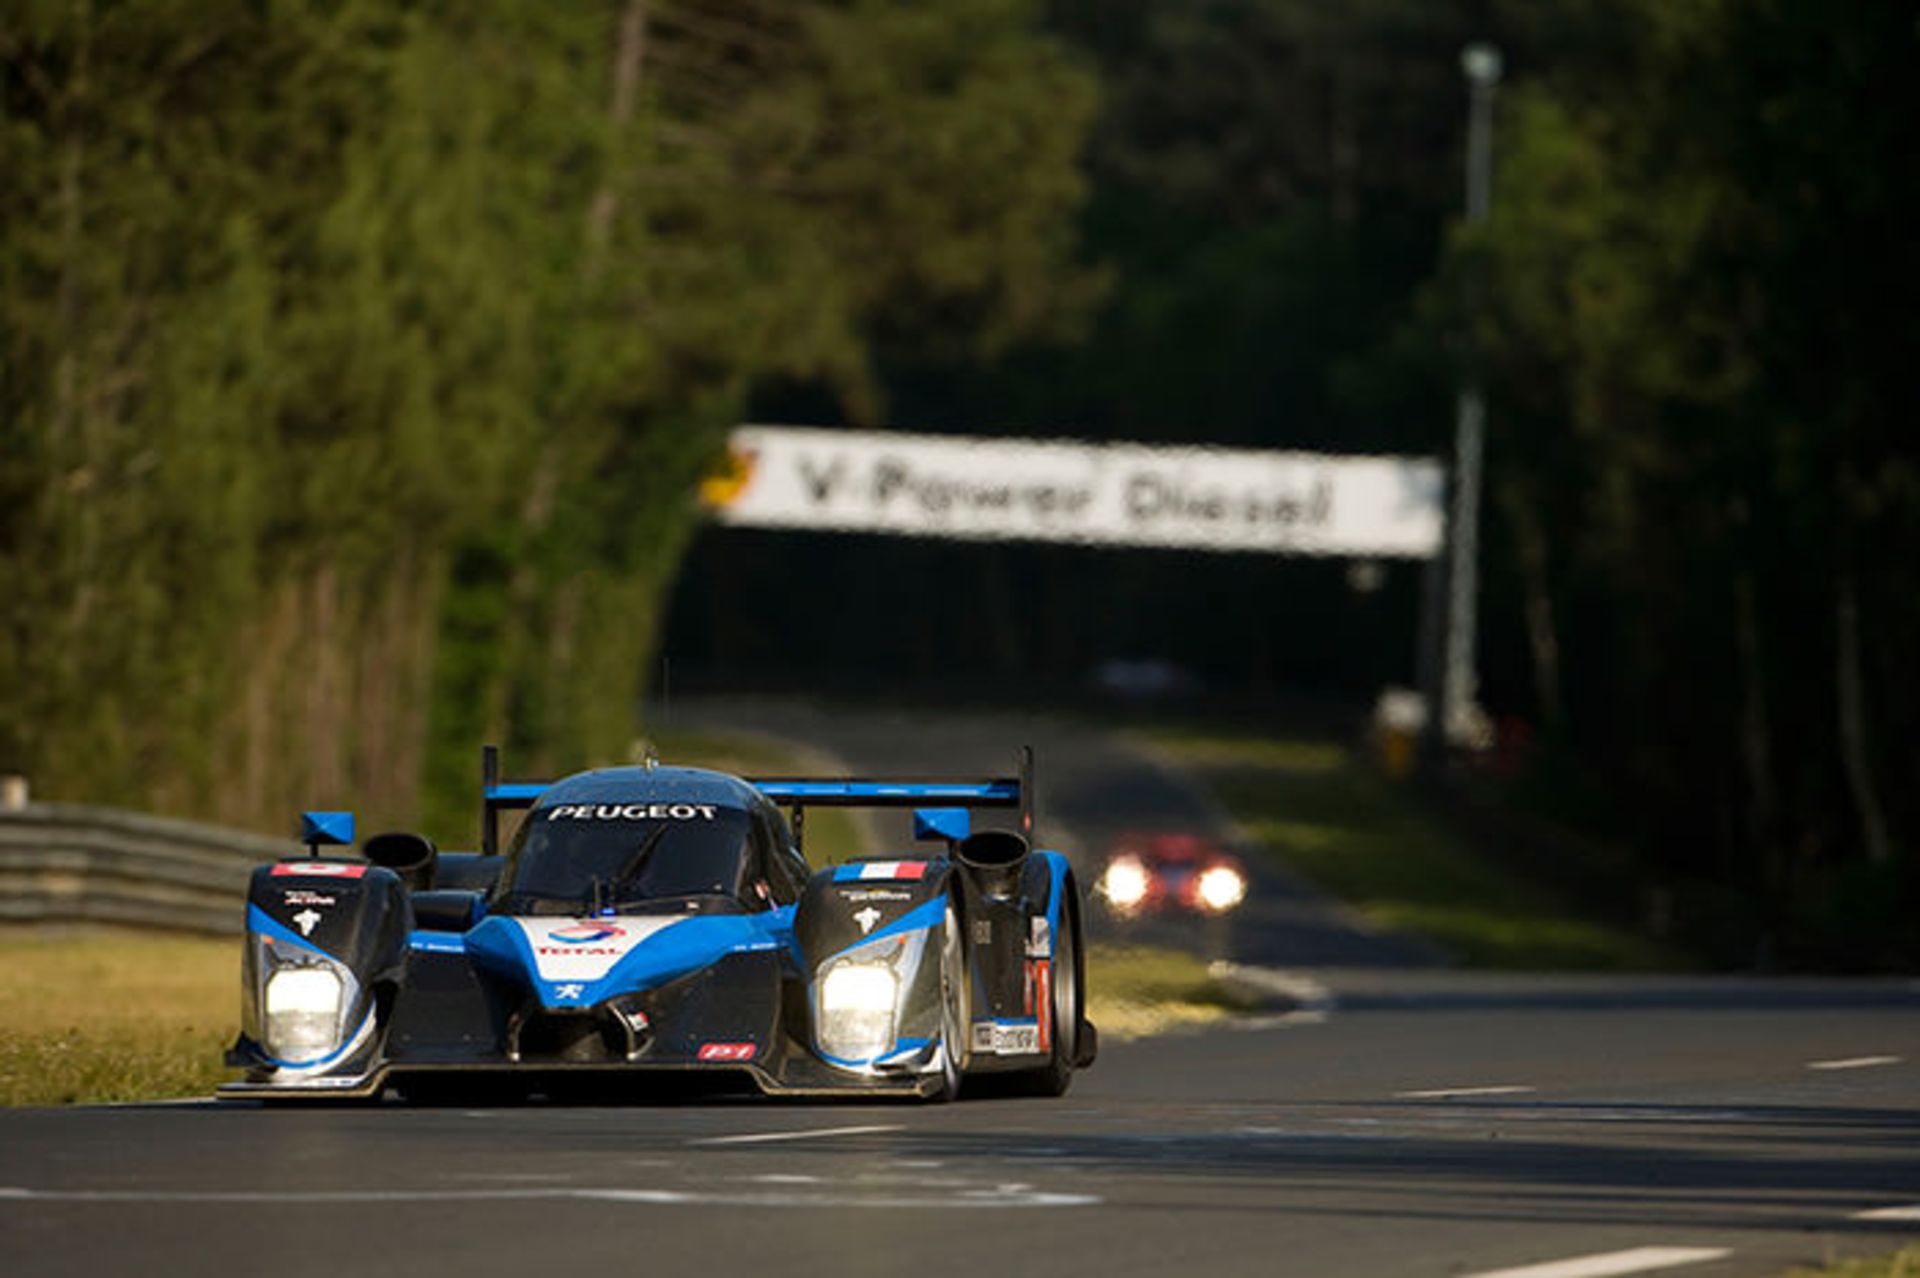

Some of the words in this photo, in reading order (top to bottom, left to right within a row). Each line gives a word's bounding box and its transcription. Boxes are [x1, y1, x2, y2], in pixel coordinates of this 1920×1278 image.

[1124, 472, 1334, 525] Diesel
[548, 805, 717, 820] PEUGEOT
[536, 945, 623, 956] TOTAL
